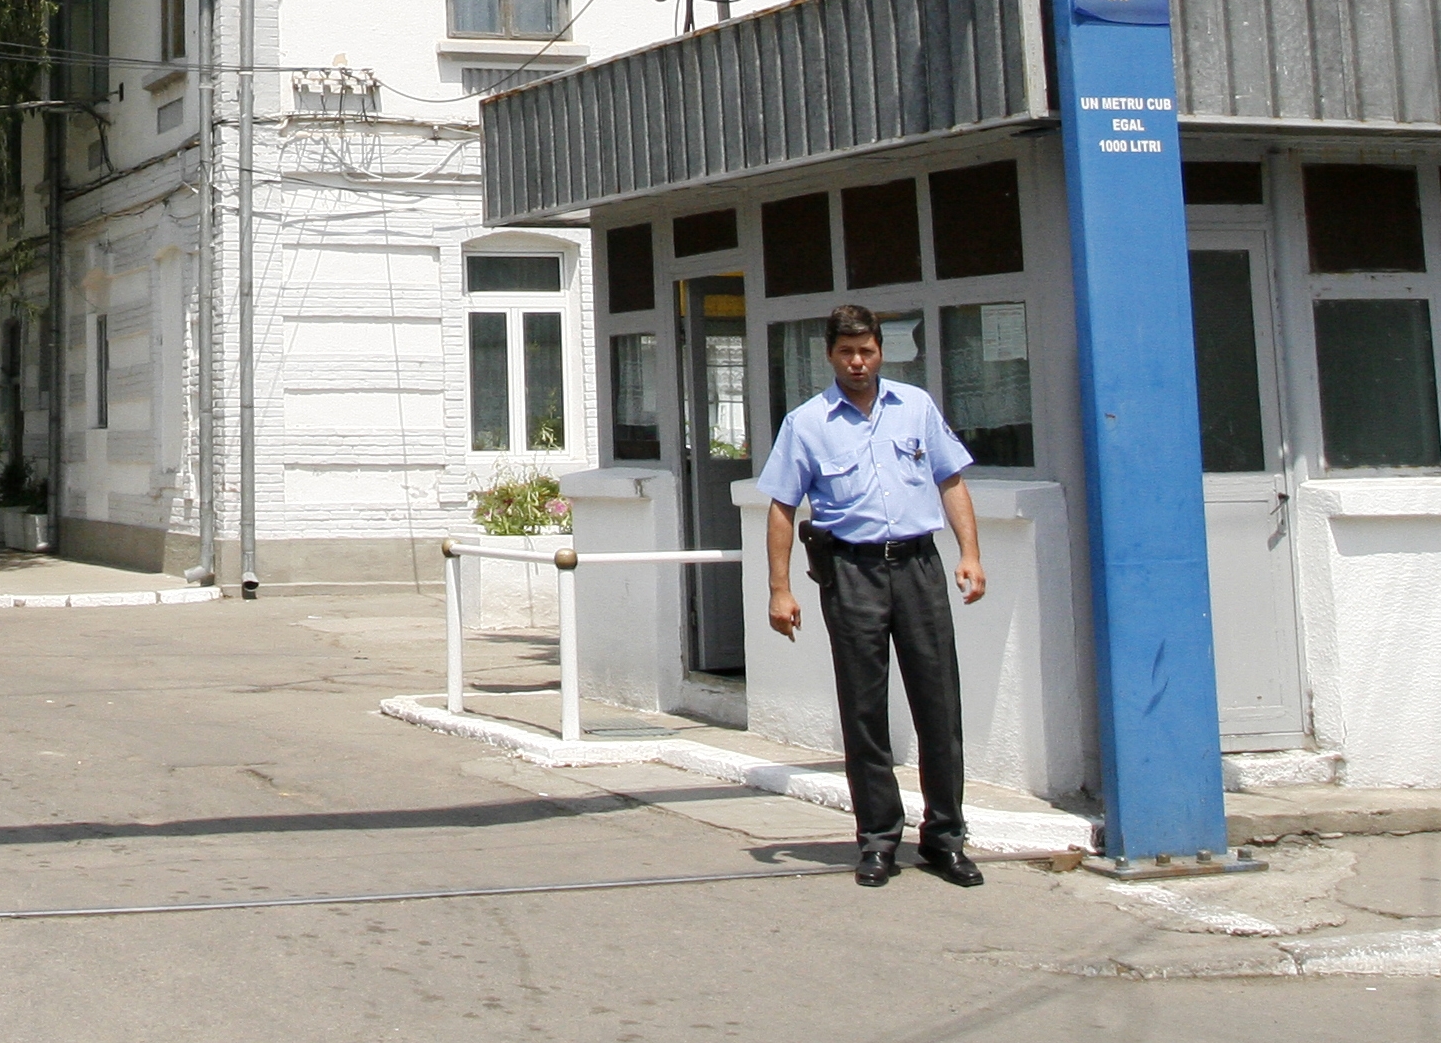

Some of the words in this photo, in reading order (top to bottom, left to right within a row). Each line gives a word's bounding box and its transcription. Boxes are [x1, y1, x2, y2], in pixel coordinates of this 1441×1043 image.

[1080, 97, 1098, 110] UN
[1102, 97, 1144, 110] METRU
[1147, 98, 1172, 111] CUB
[1112, 119, 1145, 131] EGAL
[1098, 139, 1127, 153] 1000
[1130, 140, 1162, 153] LITRI
